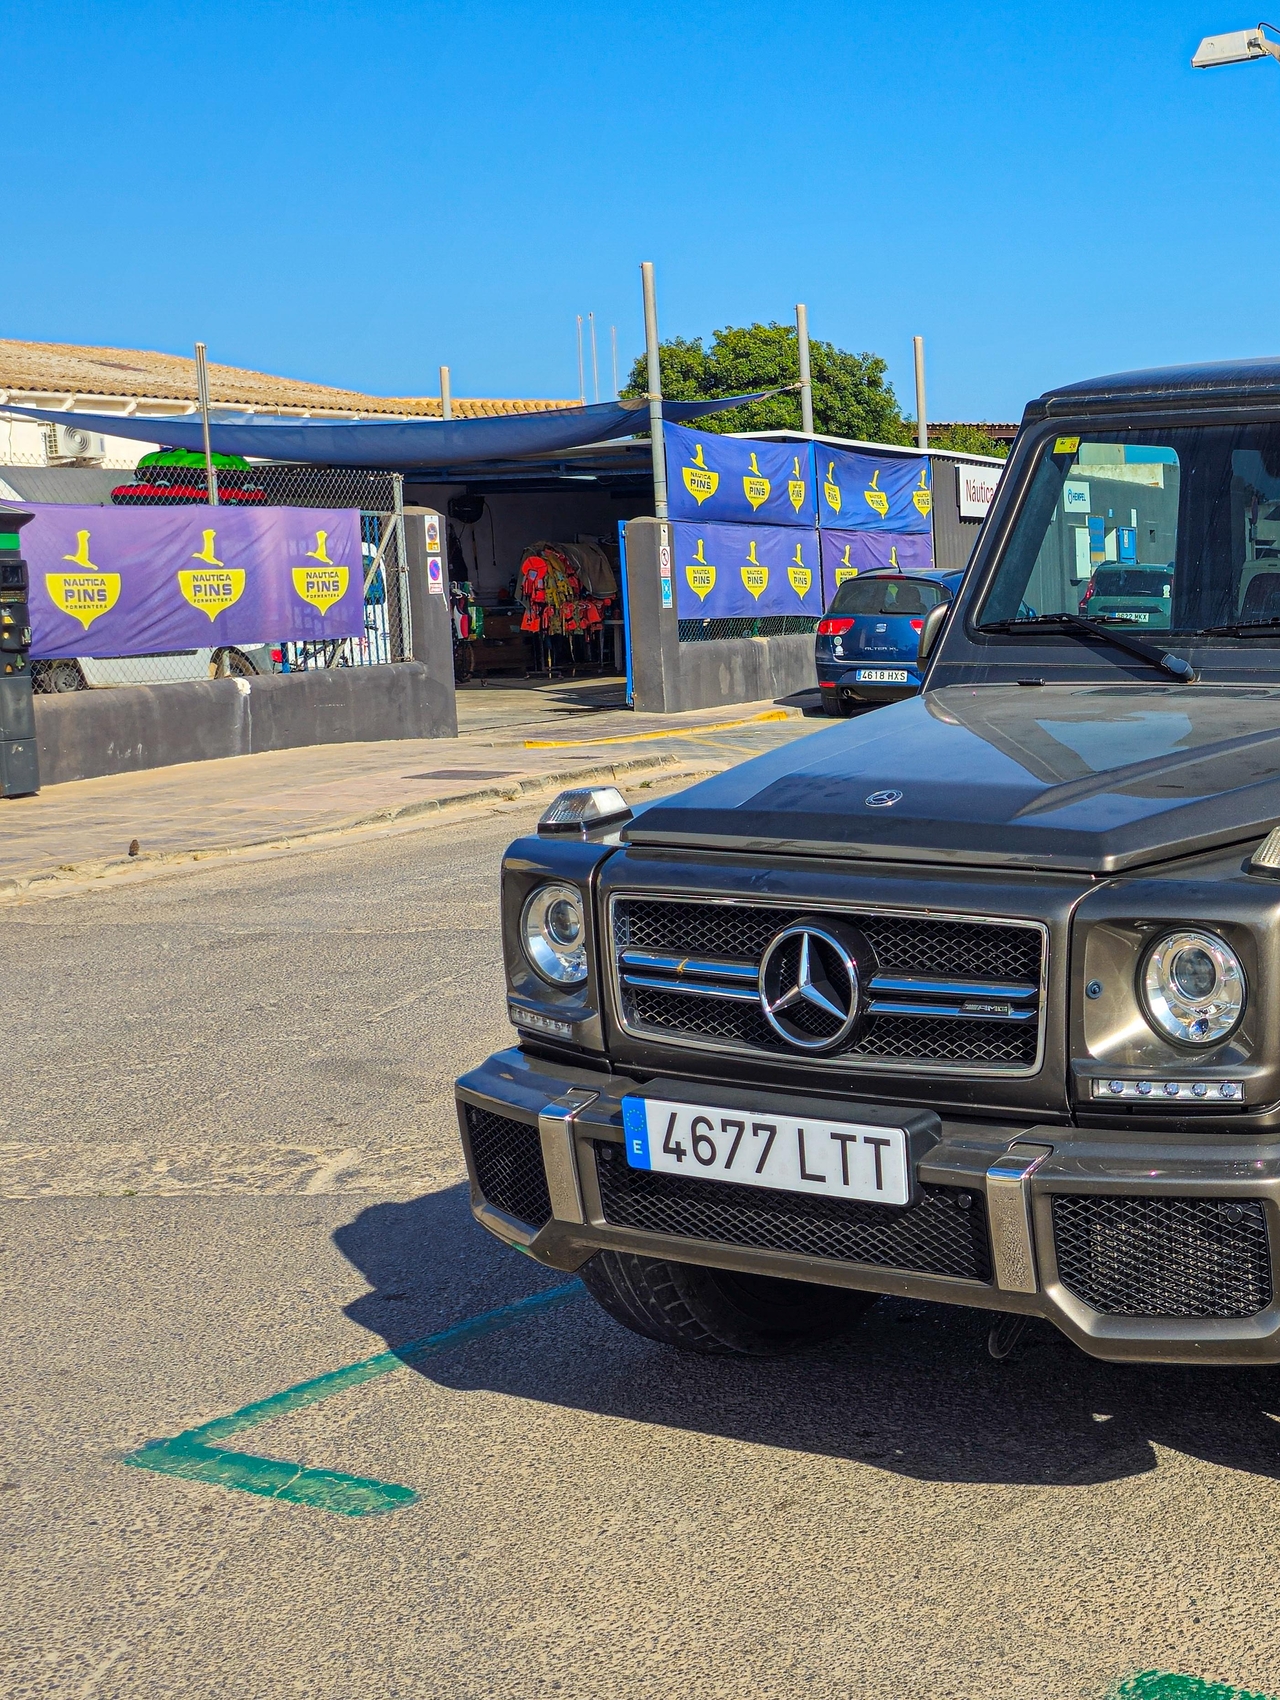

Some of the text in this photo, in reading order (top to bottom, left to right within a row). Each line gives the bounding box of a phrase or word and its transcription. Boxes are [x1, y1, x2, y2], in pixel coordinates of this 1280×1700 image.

[690, 472, 711, 480] NAUTICA
[690, 478, 712, 490] PINS
[749, 486, 765, 496] PINS
[192, 574, 232, 582] NAUTICA
[306, 571, 340, 579] NAUTICA
[63, 578, 106, 587] NAUTICA
[693, 576, 711, 585] PINS
[747, 576, 764, 585] PINS
[793, 577, 808, 585] PINS
[193, 584, 233, 597] PINS
[306, 580, 340, 593] PINS
[64, 589, 107, 603] PINS
[862, 671, 906, 681] 4618 HXS
[978, 1004, 1008, 1013] AMG
[632, 1111, 891, 1191] E 4677 LTT
